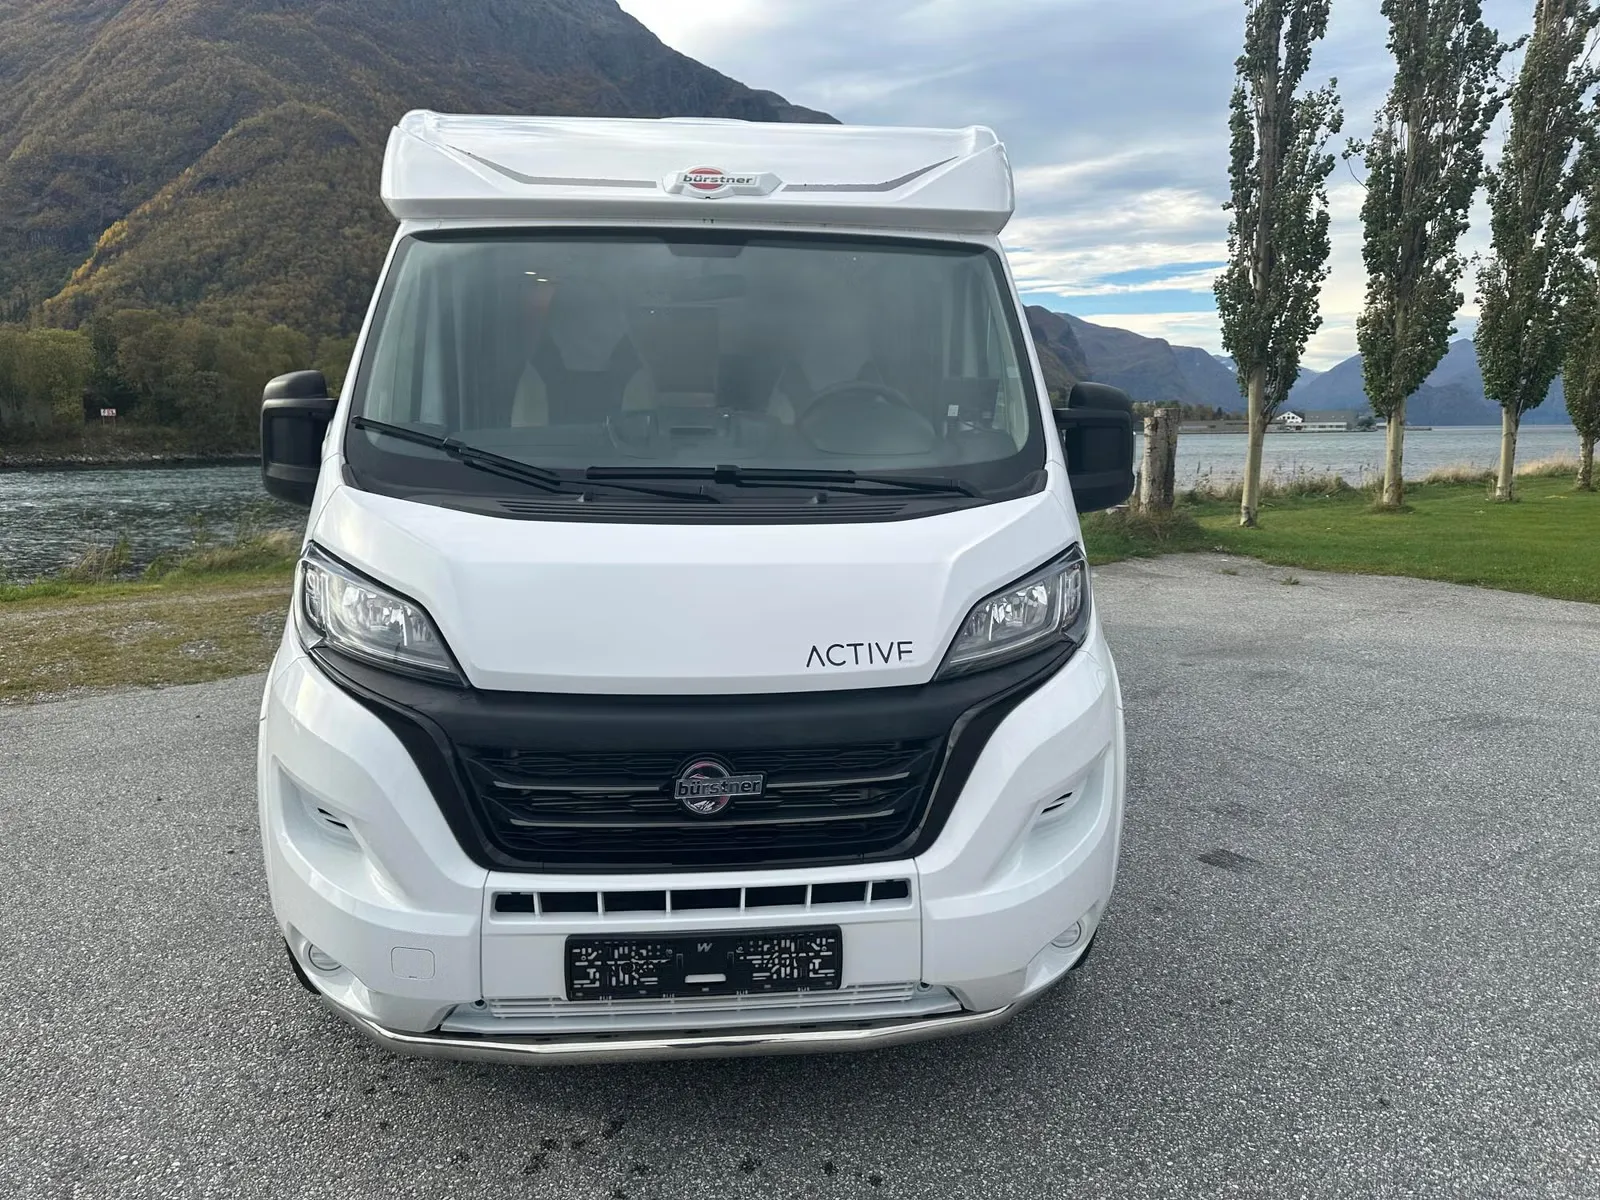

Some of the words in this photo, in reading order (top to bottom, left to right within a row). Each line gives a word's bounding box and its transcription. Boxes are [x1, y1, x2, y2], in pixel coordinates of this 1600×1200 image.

[682, 174, 753, 184] bürstner
[806, 641, 913, 668] ACTIVE
[678, 779, 761, 796] bürstner
